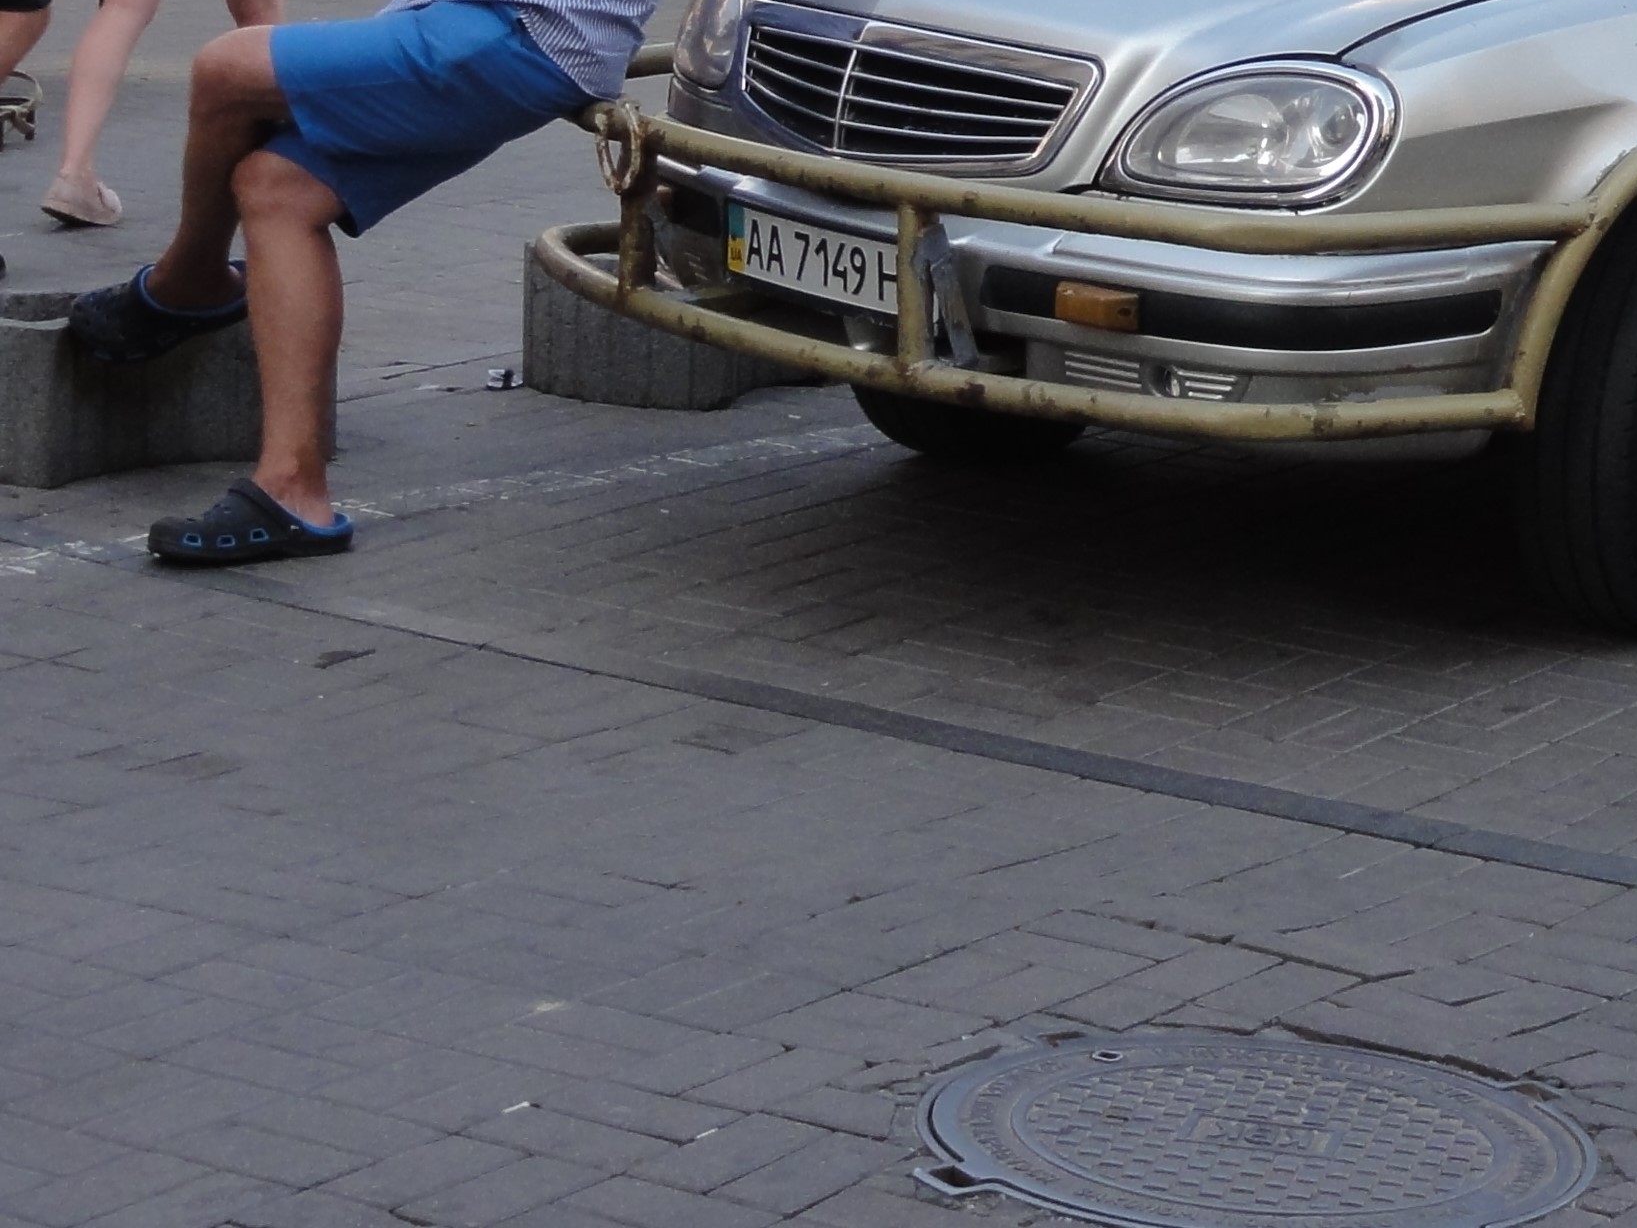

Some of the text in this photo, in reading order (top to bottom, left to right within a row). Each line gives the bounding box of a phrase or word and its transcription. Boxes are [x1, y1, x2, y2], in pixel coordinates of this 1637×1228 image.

[731, 247, 743, 262] UA
[747, 219, 898, 302] AA 7149 H
